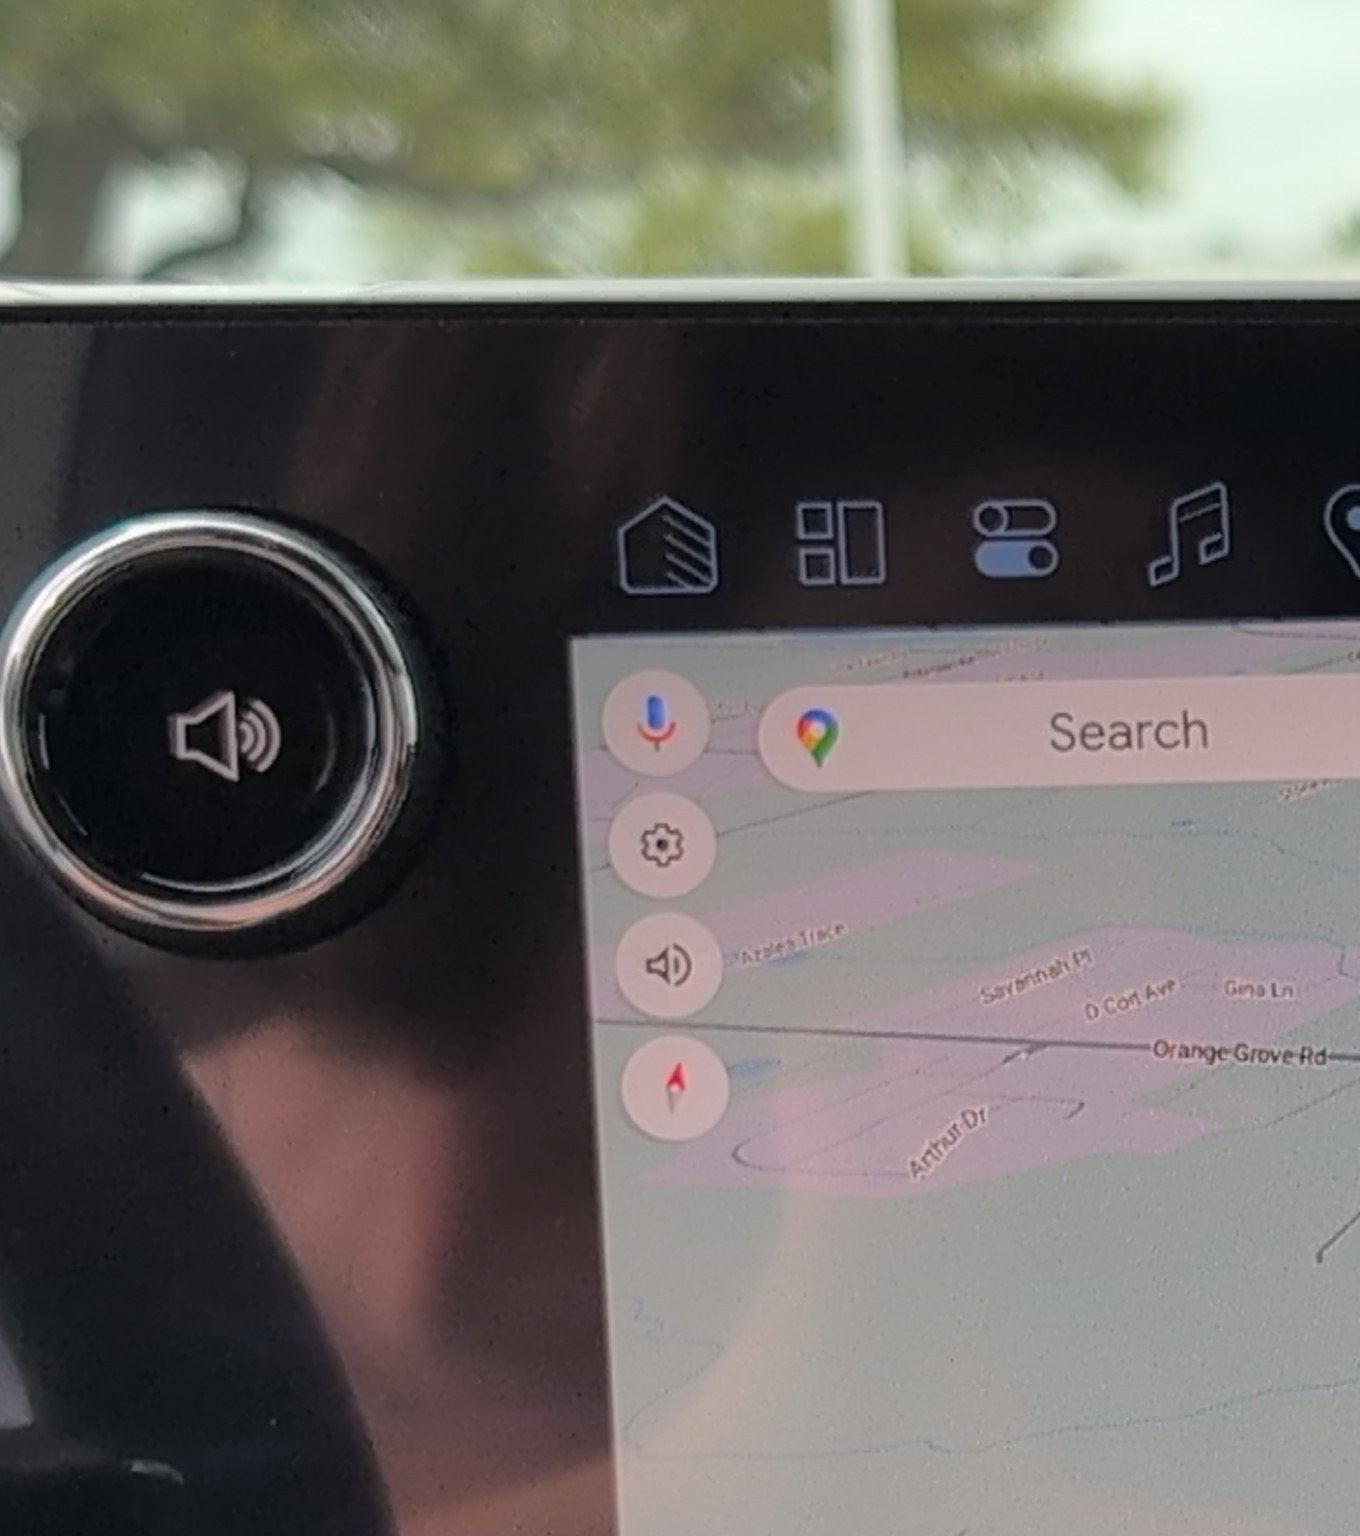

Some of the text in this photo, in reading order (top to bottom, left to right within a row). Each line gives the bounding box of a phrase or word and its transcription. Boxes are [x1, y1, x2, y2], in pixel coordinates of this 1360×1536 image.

[1050, 710, 1209, 752] Search
[980, 949, 1093, 1004] Savannah Pl
[1142, 978, 1178, 1000] Ave
[1225, 979, 1294, 998] Gina Ln
[1153, 1039, 1328, 1067] Orange Grove Rd
[908, 1102, 989, 1180] Arthur Dr
